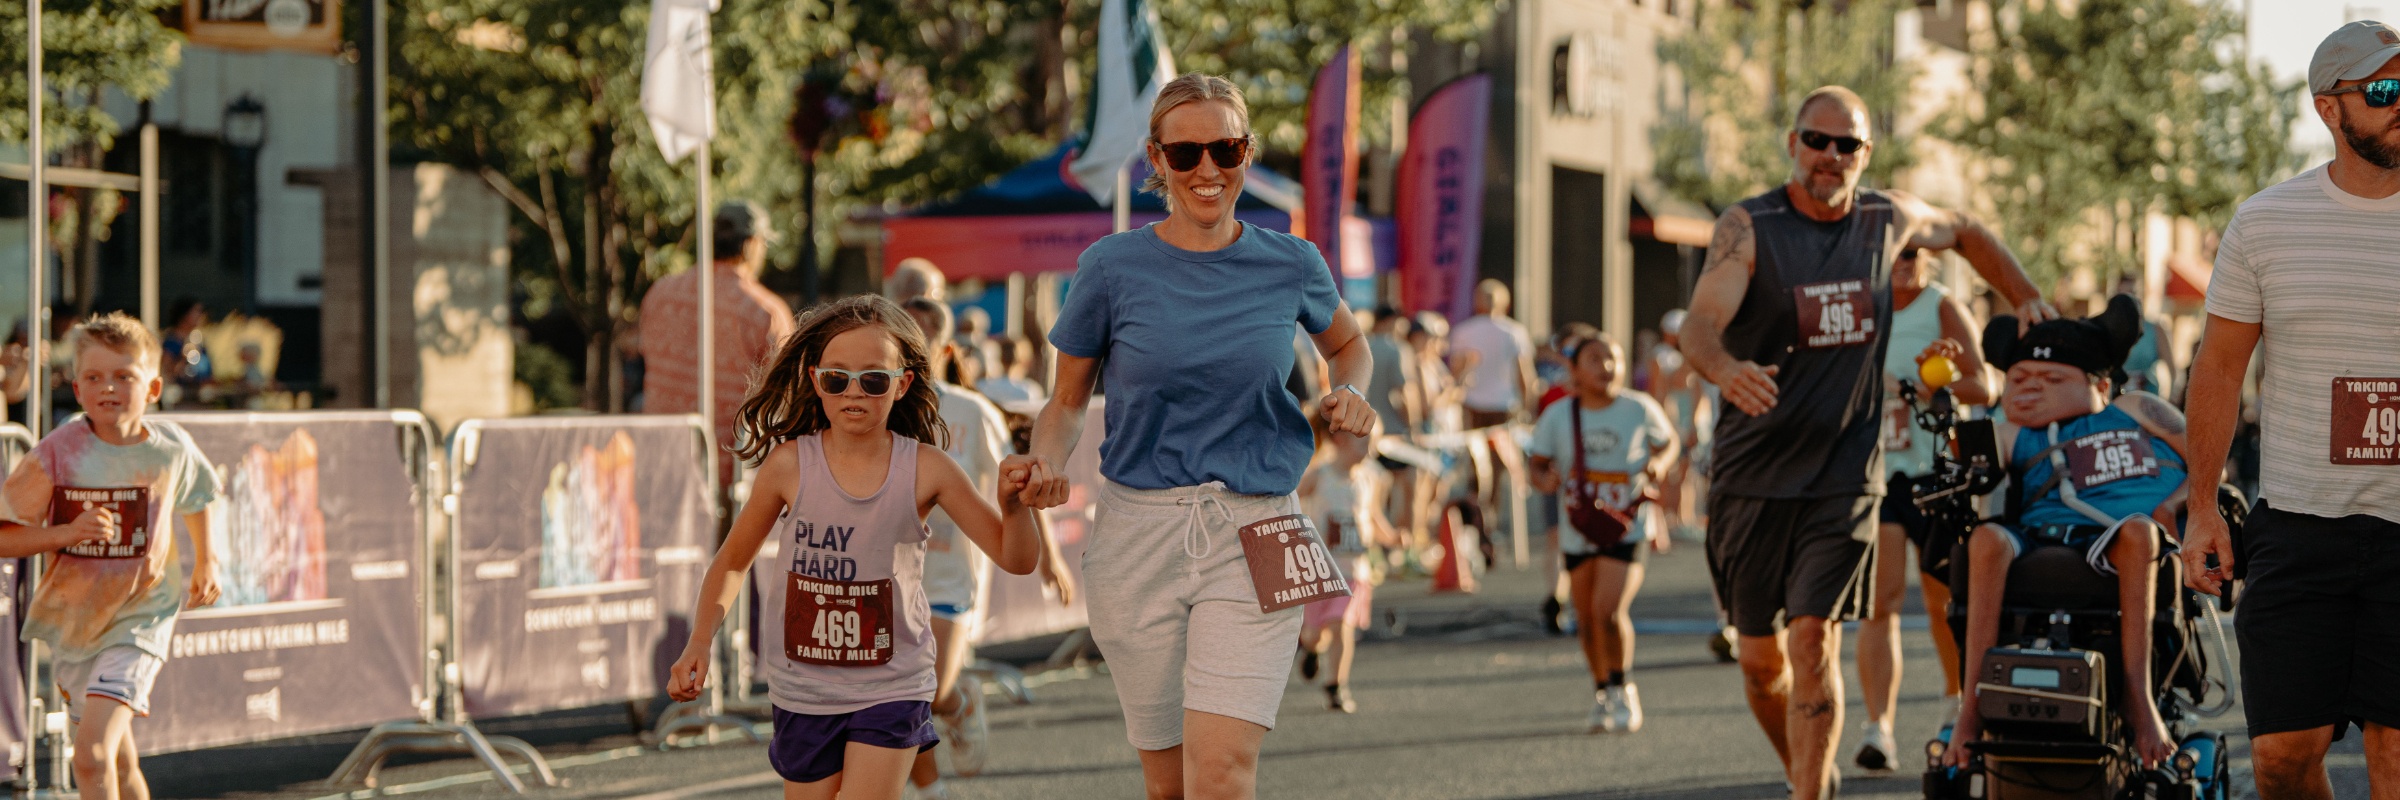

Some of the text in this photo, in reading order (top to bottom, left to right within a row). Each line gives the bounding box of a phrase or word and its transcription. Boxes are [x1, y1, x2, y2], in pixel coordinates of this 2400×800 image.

[1819, 302, 1854, 334] 496
[2346, 381, 2397, 393] YAKIMA
[2362, 408, 2400, 446] 49
[2095, 445, 2133, 472] 495
[2346, 447, 2394, 459] FAMILY
[65, 489, 138, 501] YAKIMA MILE
[794, 519, 855, 552] PLAY
[1253, 518, 1302, 537] YAKIMA
[65, 545, 136, 557] FAMILY MILE
[791, 547, 857, 582] HARD
[1284, 542, 1331, 585] 498
[797, 578, 879, 596] YAKIMA MILE
[1274, 583, 1319, 604] FAMILY
[525, 605, 594, 632] DOWNTOWN
[811, 609, 861, 649] 469
[173, 619, 349, 658] DOWNTOWN YAKIMA MILE
[797, 645, 878, 661] FAMILY MILE
